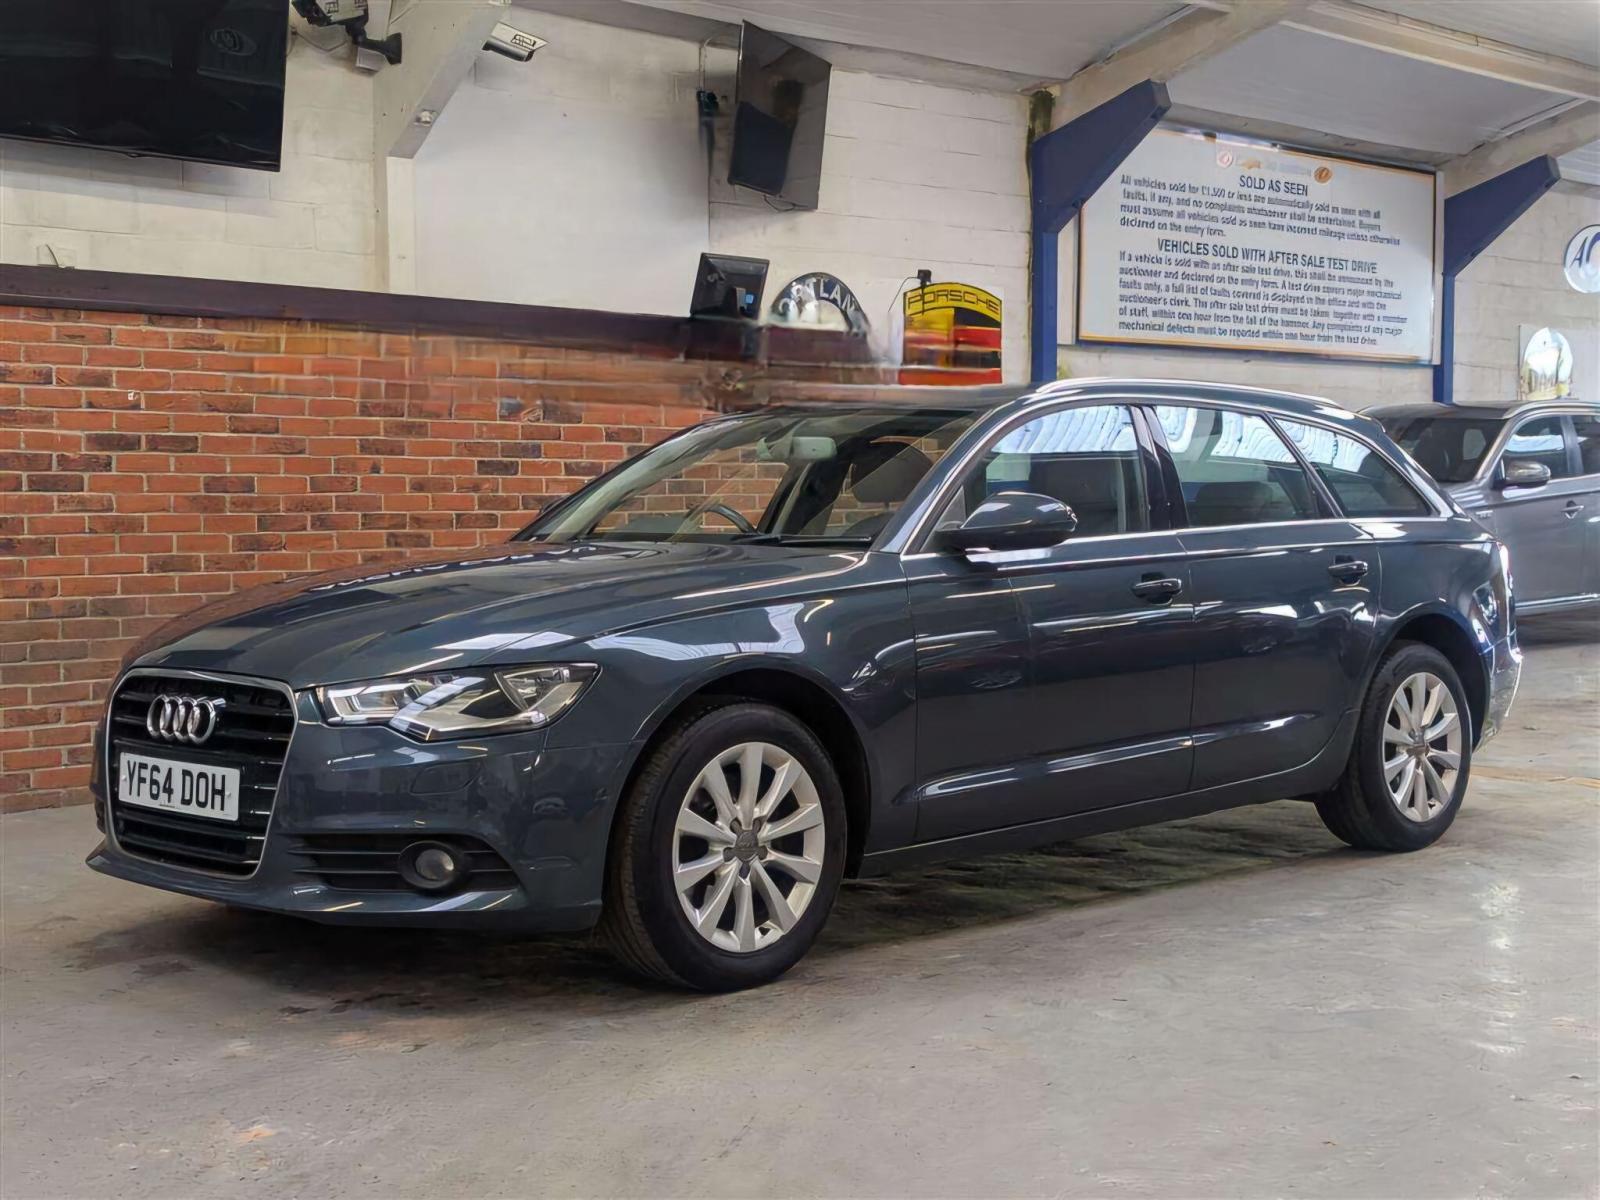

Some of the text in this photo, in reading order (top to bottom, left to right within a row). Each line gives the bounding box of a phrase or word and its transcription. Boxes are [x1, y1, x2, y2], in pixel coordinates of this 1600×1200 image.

[1134, 176, 1166, 190] vehicles
[1240, 175, 1308, 196] SOLD AS SEEN
[1158, 238, 1377, 273] VEHICLES SOLD WITH AFTER SALE TEST DRIVE
[907, 289, 999, 315] PORSCHE
[127, 760, 226, 812] YF64 DOH
